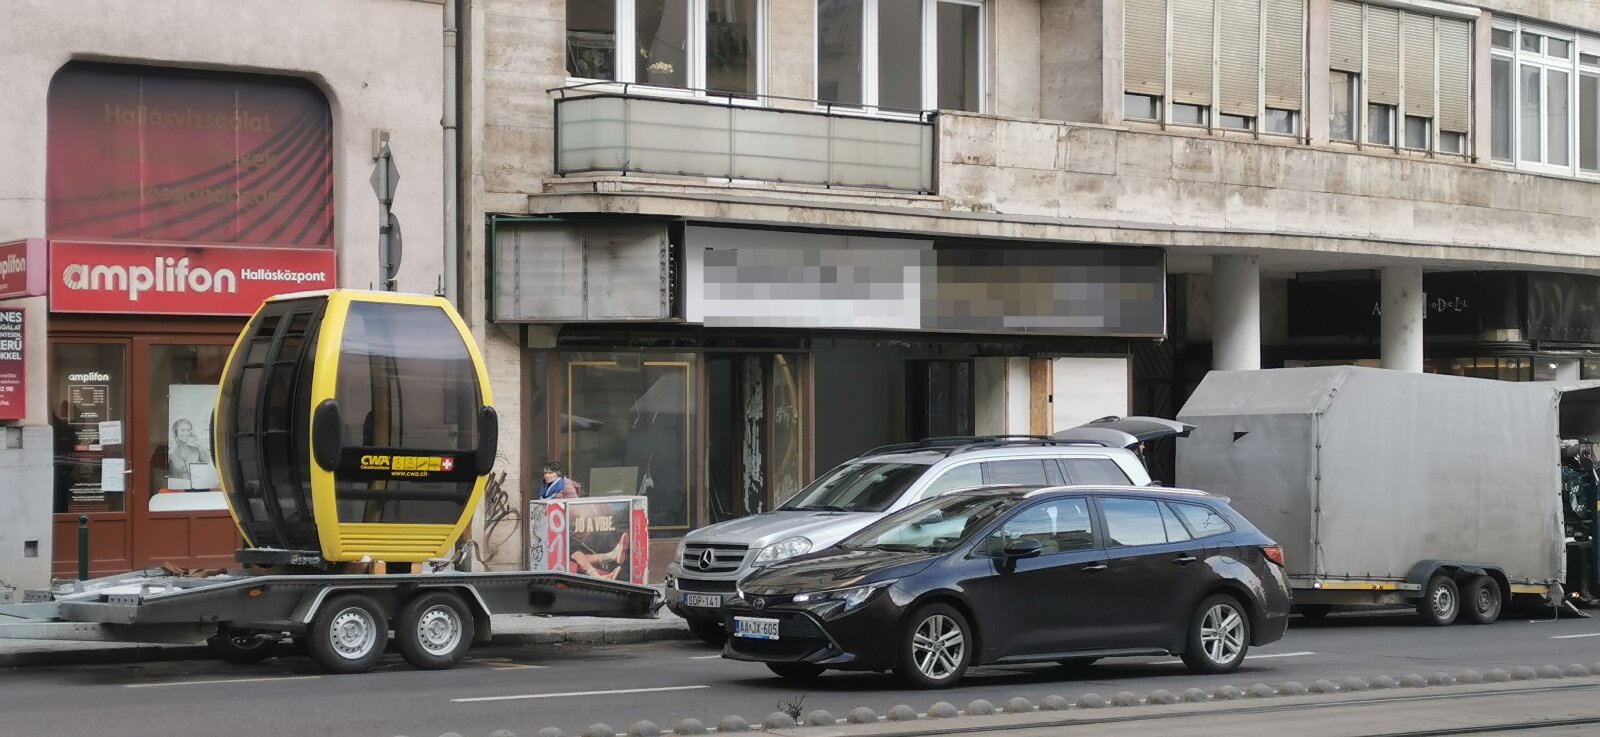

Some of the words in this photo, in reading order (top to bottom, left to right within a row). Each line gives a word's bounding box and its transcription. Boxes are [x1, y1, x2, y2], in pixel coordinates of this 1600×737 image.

[104, 103, 273, 135] Hallásvizsgálat
[62, 256, 236, 301] amplifon
[241, 268, 326, 284] Hallásközpont
[0, 337, 22, 351] ERŰ
[68, 371, 109, 383] amplifon
[361, 455, 390, 466] CWA
[574, 514, 585, 533] JÓ
[586, 517, 594, 533] A
[595, 516, 616, 532] VIBE.
